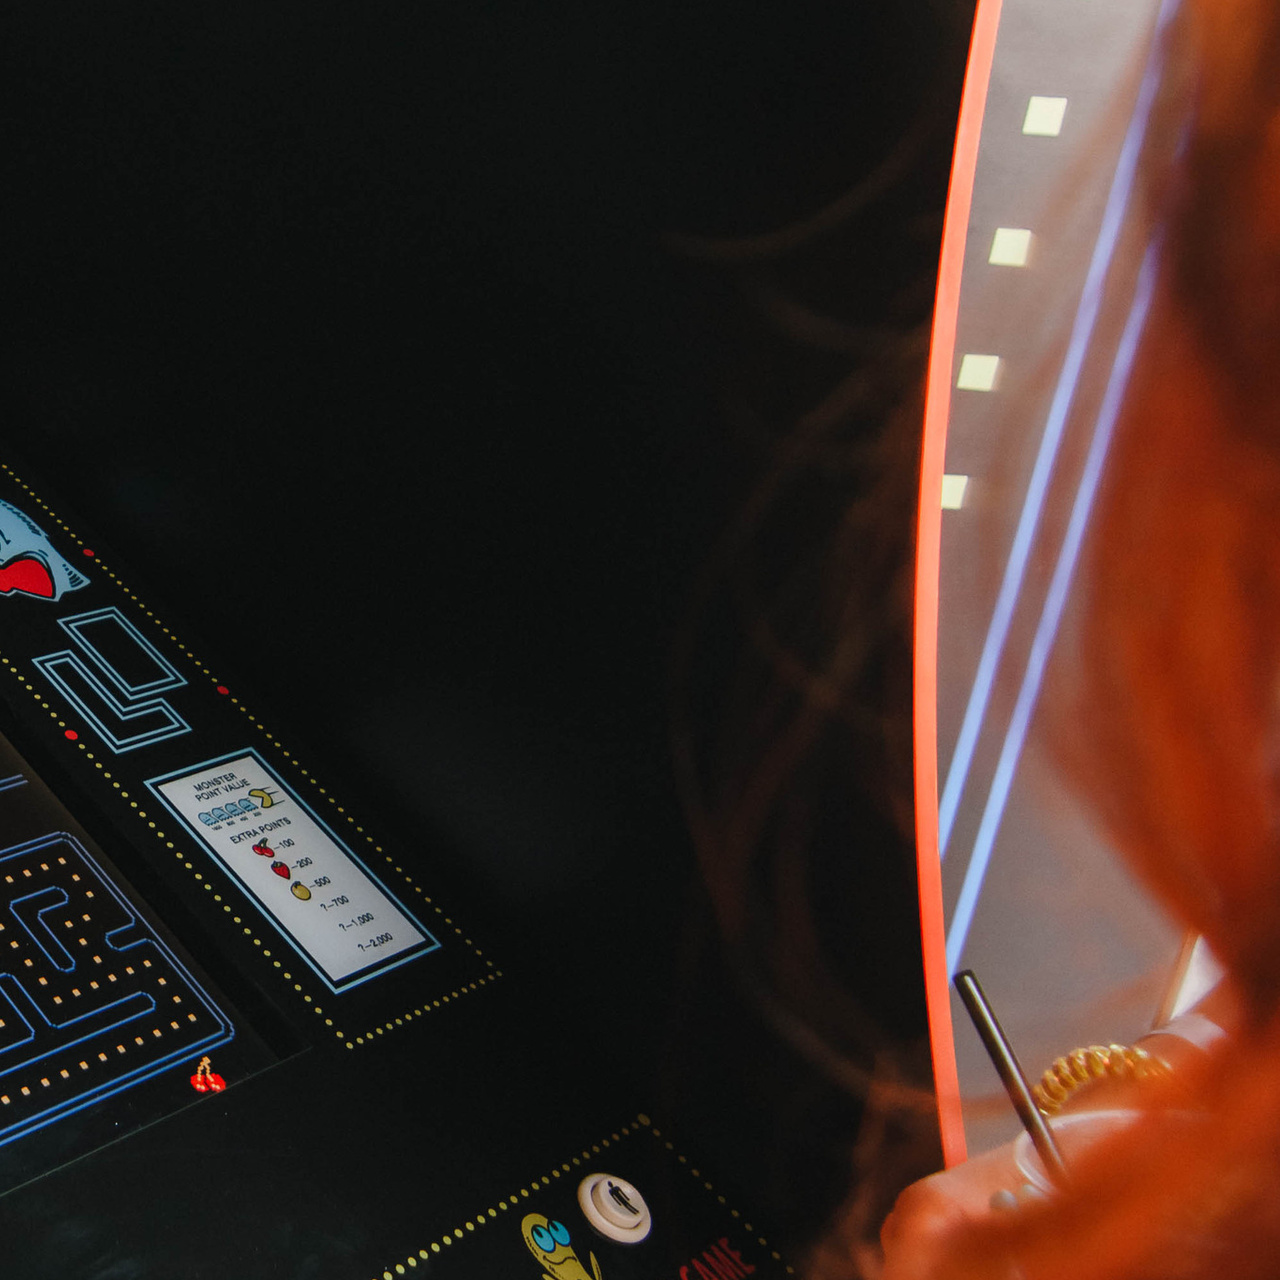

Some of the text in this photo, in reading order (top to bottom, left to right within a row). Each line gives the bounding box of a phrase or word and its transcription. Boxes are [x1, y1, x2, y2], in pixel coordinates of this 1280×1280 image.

[193, 772, 237, 791] MONSTER
[195, 778, 251, 801] POINT VALUE
[230, 817, 292, 844] EXTRA POINTS
